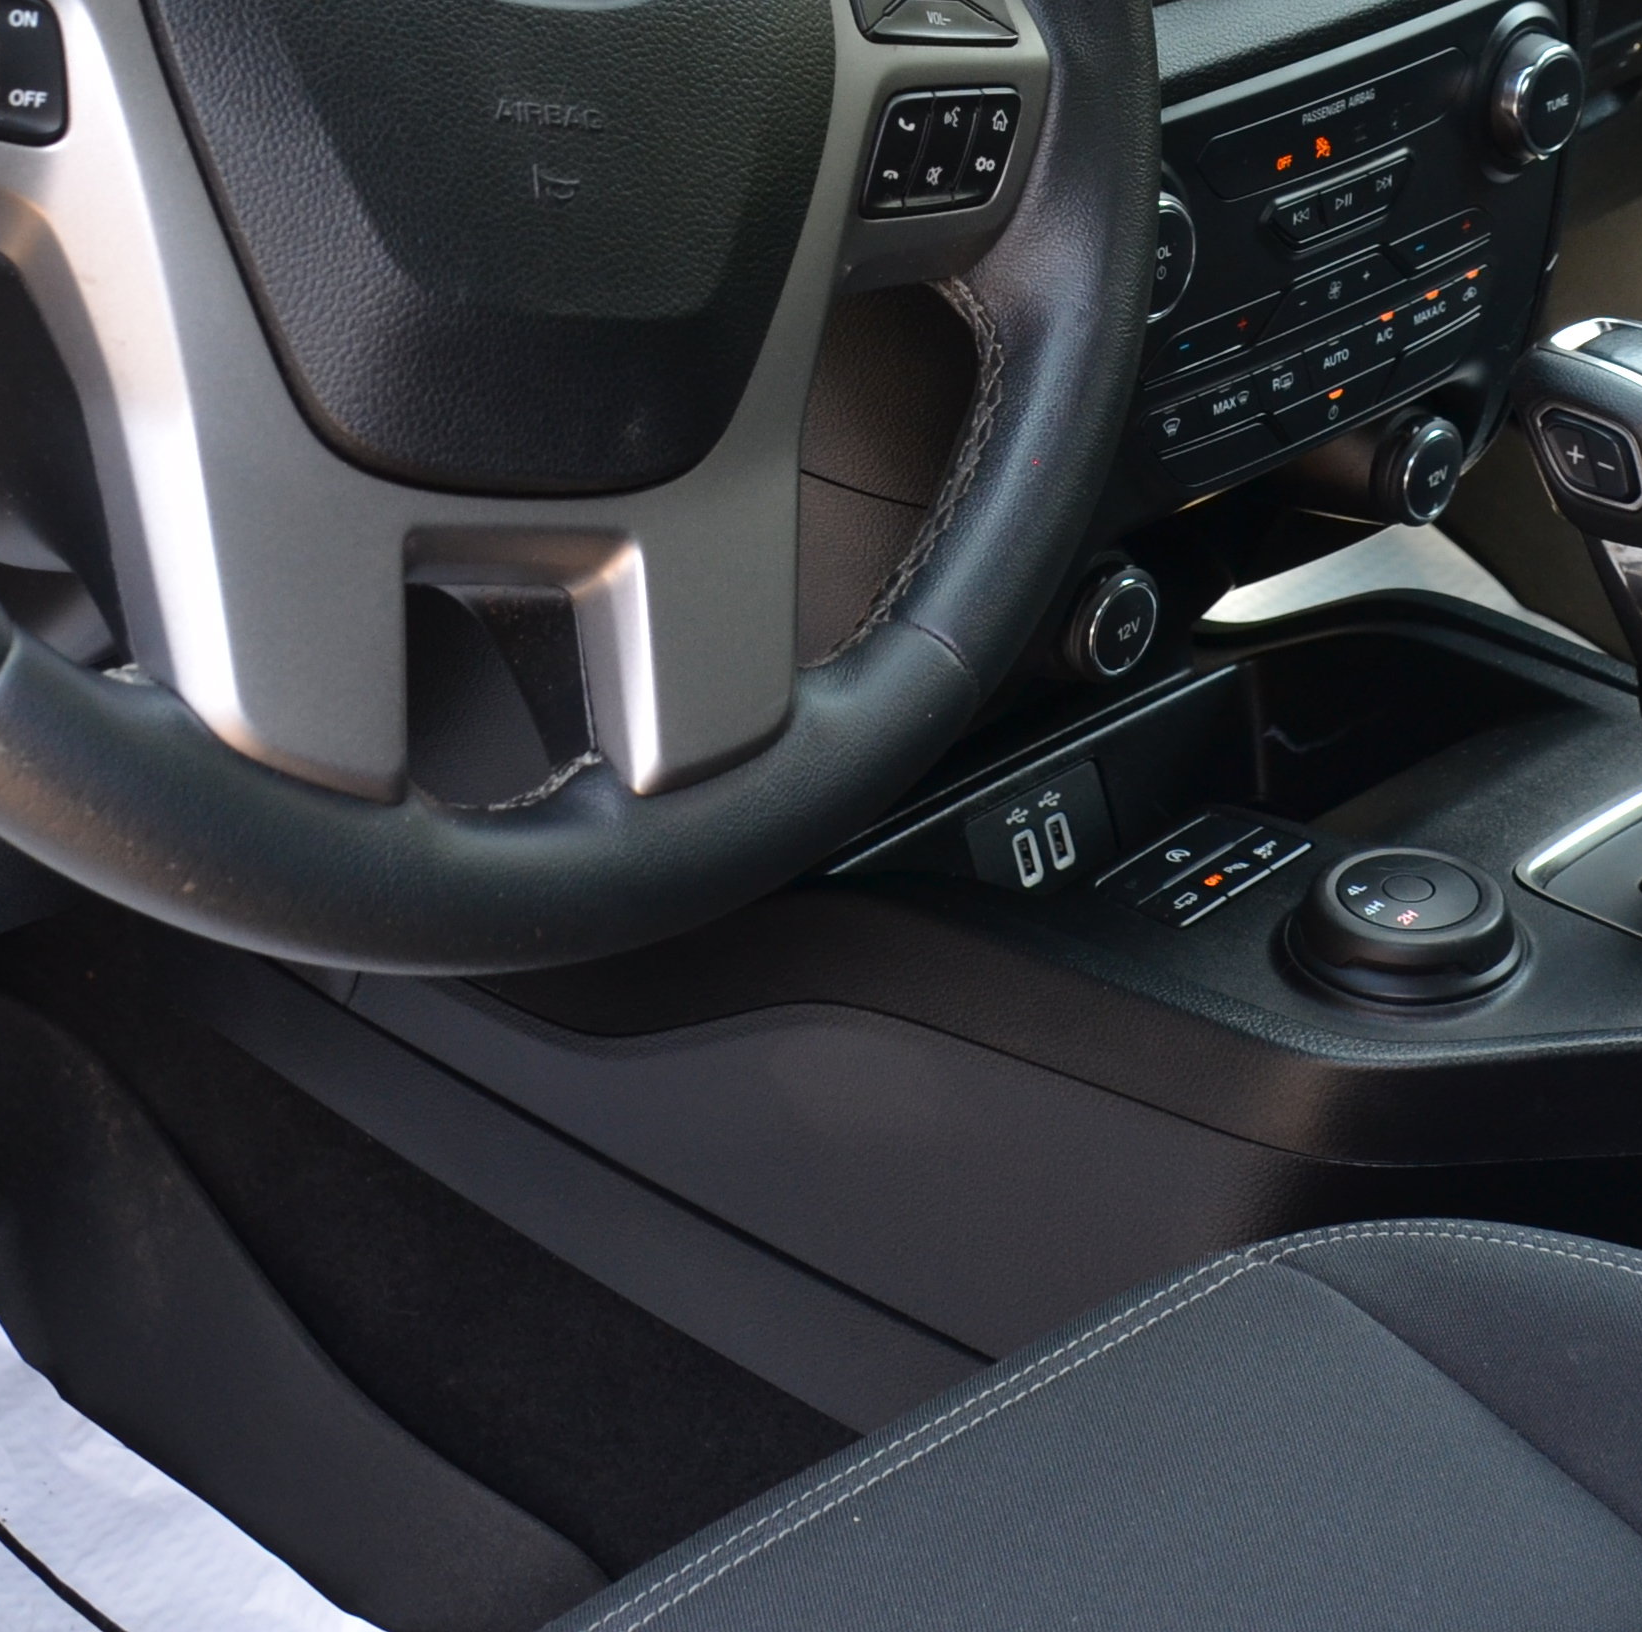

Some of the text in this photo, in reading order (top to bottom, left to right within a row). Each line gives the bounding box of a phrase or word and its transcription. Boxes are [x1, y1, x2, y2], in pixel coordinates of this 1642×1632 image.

[9, 10, 38, 29] ON
[9, 89, 47, 108] OFF
[1302, 87, 1376, 126] PASSENGER AIRBAG
[1545, 93, 1570, 113] TUNE
[1276, 154, 1293, 171] OFF
[1157, 245, 1172, 260] OL
[1375, 327, 1394, 344] A/C
[1323, 348, 1350, 369] AUTO
[1212, 397, 1237, 416] MAX
[1428, 466, 1449, 488] 12V
[1117, 616, 1141, 641] 12V
[1346, 884, 1368, 896] 4L
[1364, 899, 1386, 916] 4H
[1396, 909, 1420, 926] 2H
